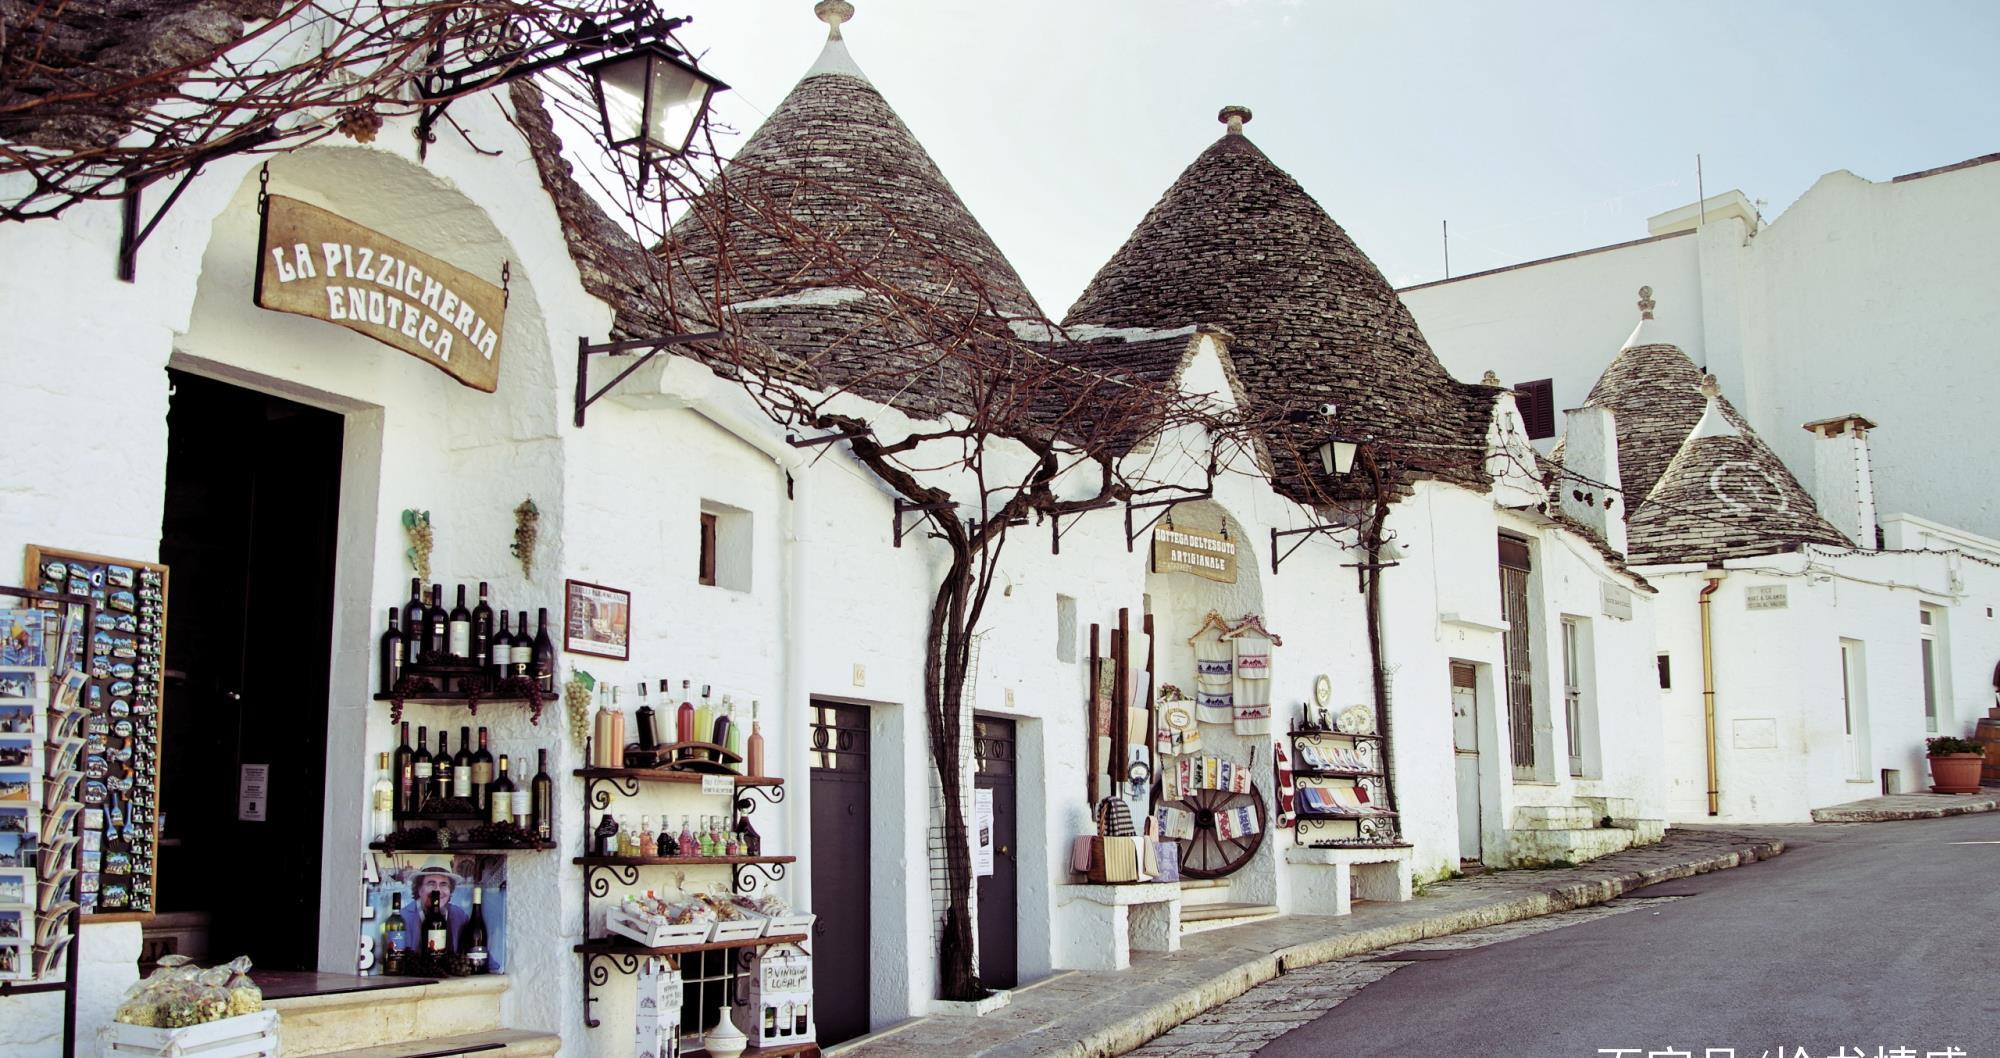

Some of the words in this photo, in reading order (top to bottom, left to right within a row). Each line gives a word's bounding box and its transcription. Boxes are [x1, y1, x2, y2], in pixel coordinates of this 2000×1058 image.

[272, 242, 317, 283] LA
[322, 242, 498, 361] PIZZICHERIA
[325, 286, 454, 362] ENOTECA
[1155, 528, 1189, 546] BOTTEGA
[1171, 549, 1226, 571] ARTIGIANALE
